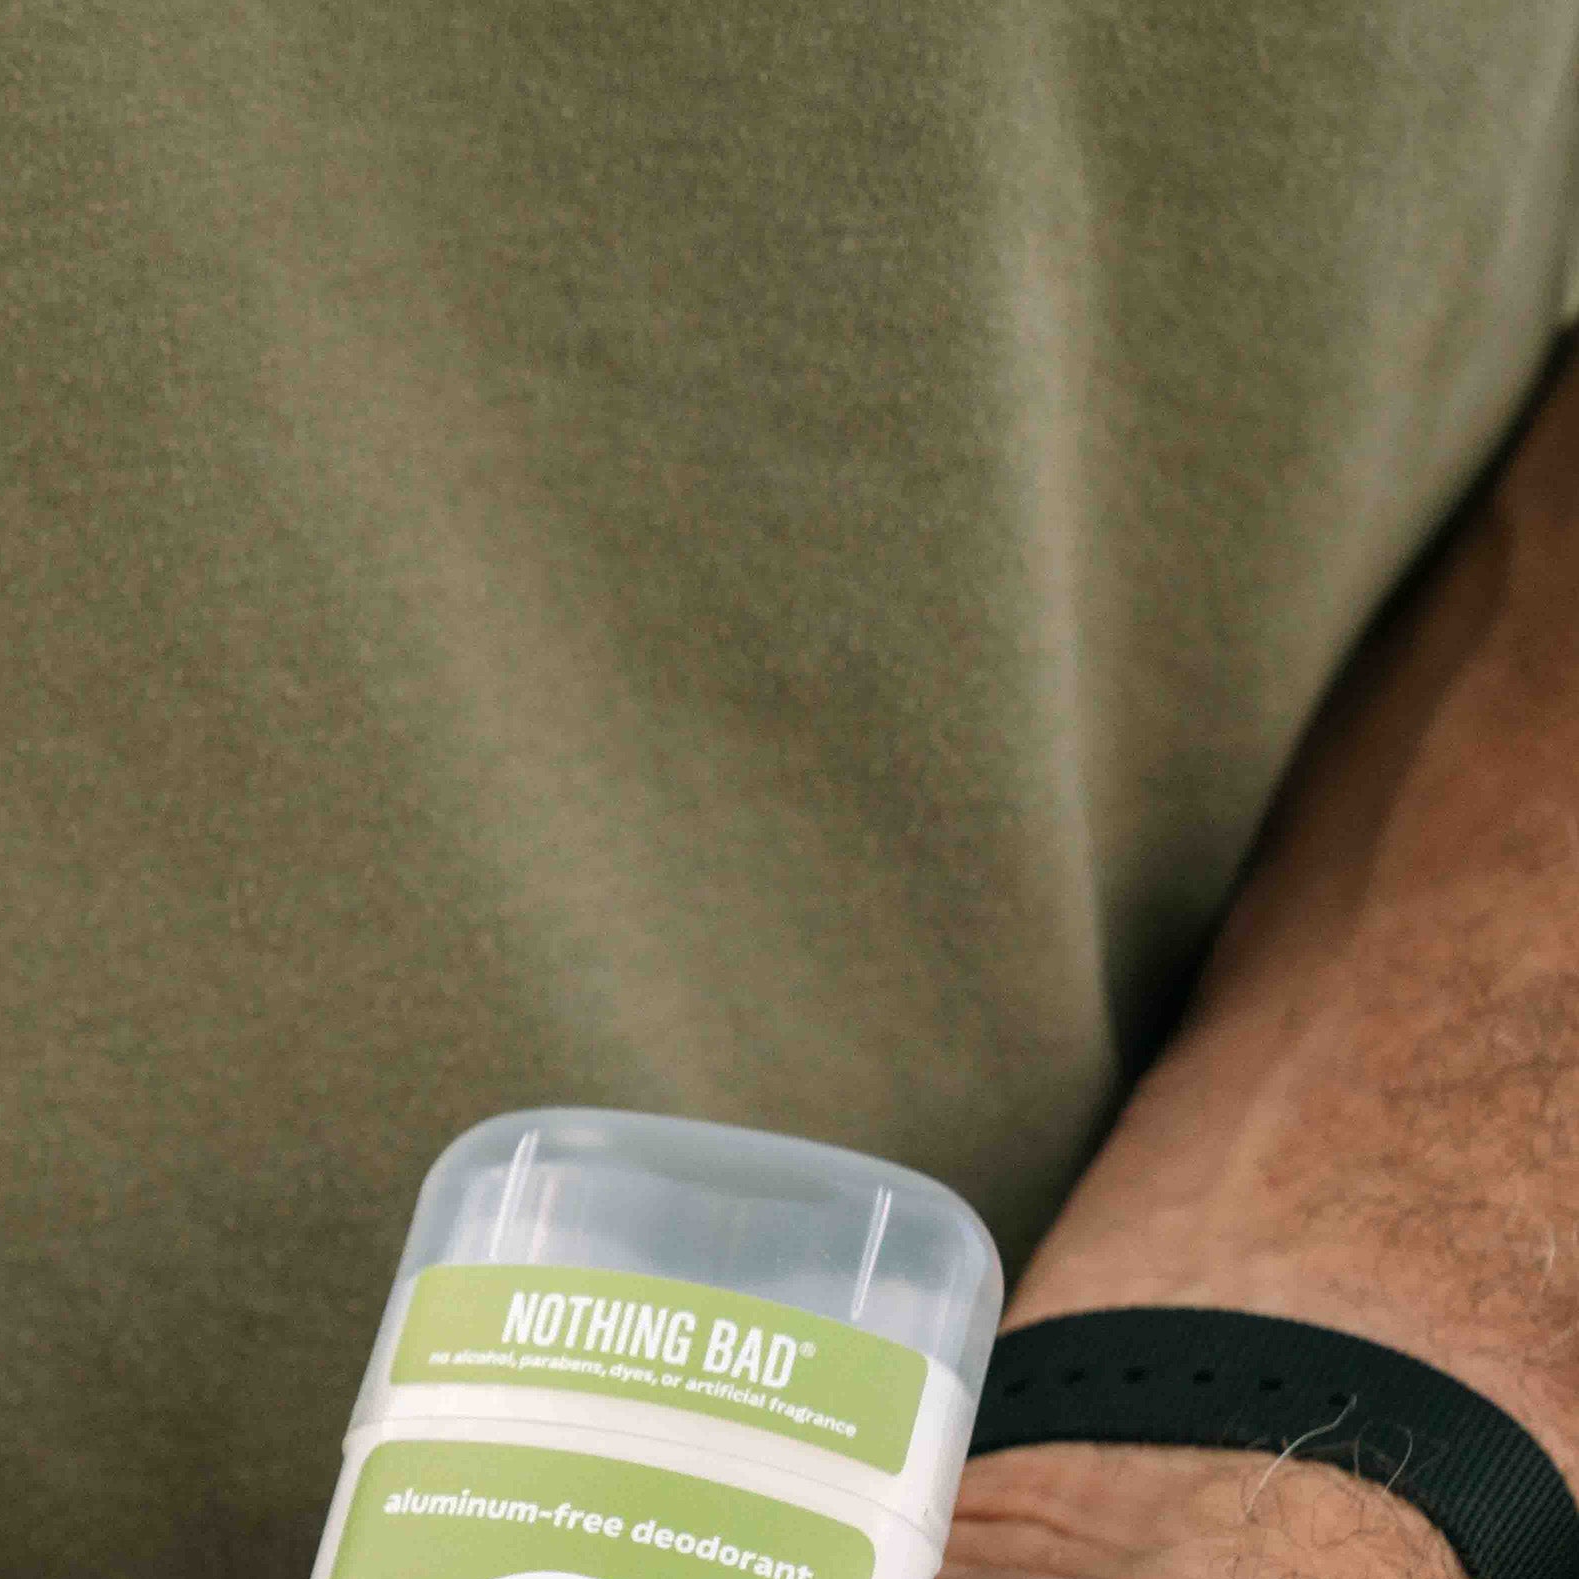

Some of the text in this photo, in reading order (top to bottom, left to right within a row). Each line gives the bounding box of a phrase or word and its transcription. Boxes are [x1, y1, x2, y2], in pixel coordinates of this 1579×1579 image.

[502, 1291, 697, 1367] NOTHING
[428, 1348, 857, 1438] no alcohol, parabens, dyes, or artificial fragrance
[384, 1487, 623, 1540] aluminum-free
